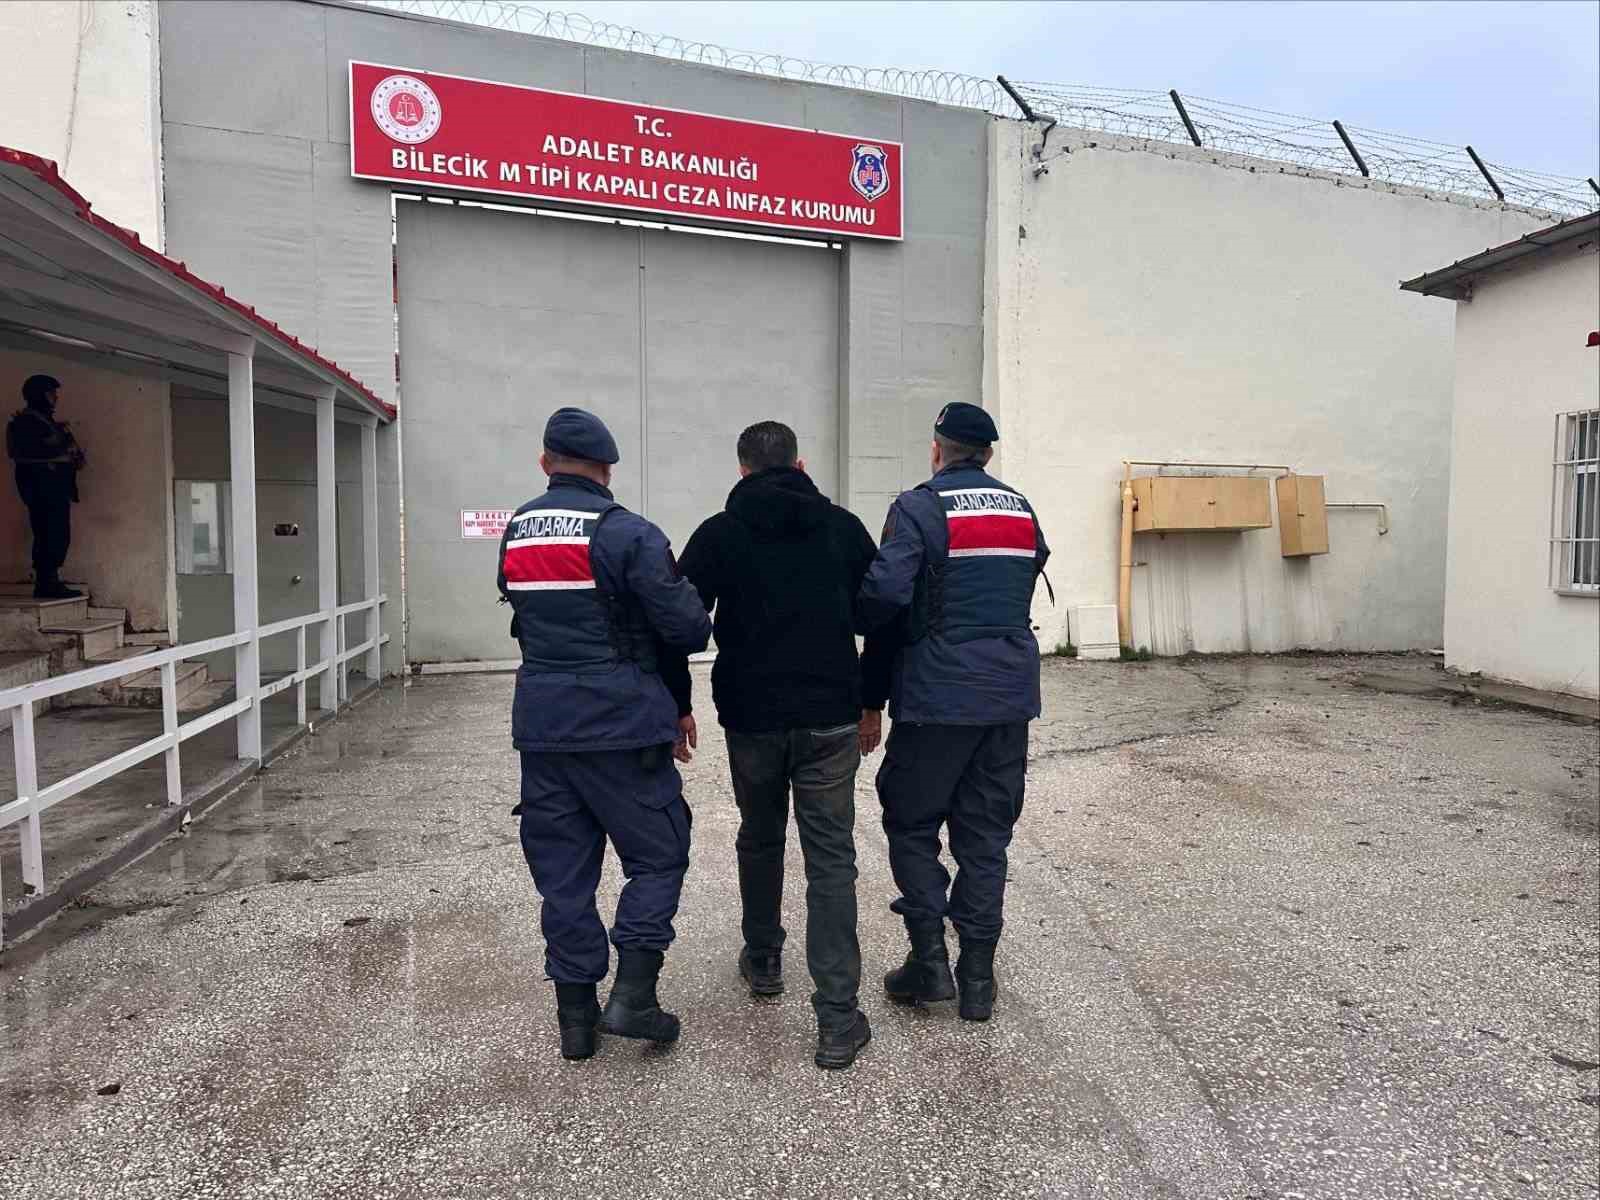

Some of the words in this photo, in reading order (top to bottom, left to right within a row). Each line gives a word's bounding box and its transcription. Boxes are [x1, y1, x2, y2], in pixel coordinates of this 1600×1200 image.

[634, 115, 672, 137] T.C.
[542, 135, 633, 164] ADALET
[641, 149, 758, 181] BAKANLIĞI
[392, 147, 487, 178] BİLECİK
[500, 162, 520, 183] M
[526, 162, 571, 189] TİPİ
[577, 172, 657, 200] KAPALI
[663, 183, 719, 208] CEZA
[725, 187, 786, 214] İNFAZ
[791, 199, 876, 226] KURUMU
[953, 493, 1024, 512] JANDARMA
[514, 517, 584, 538] JANDARMA
